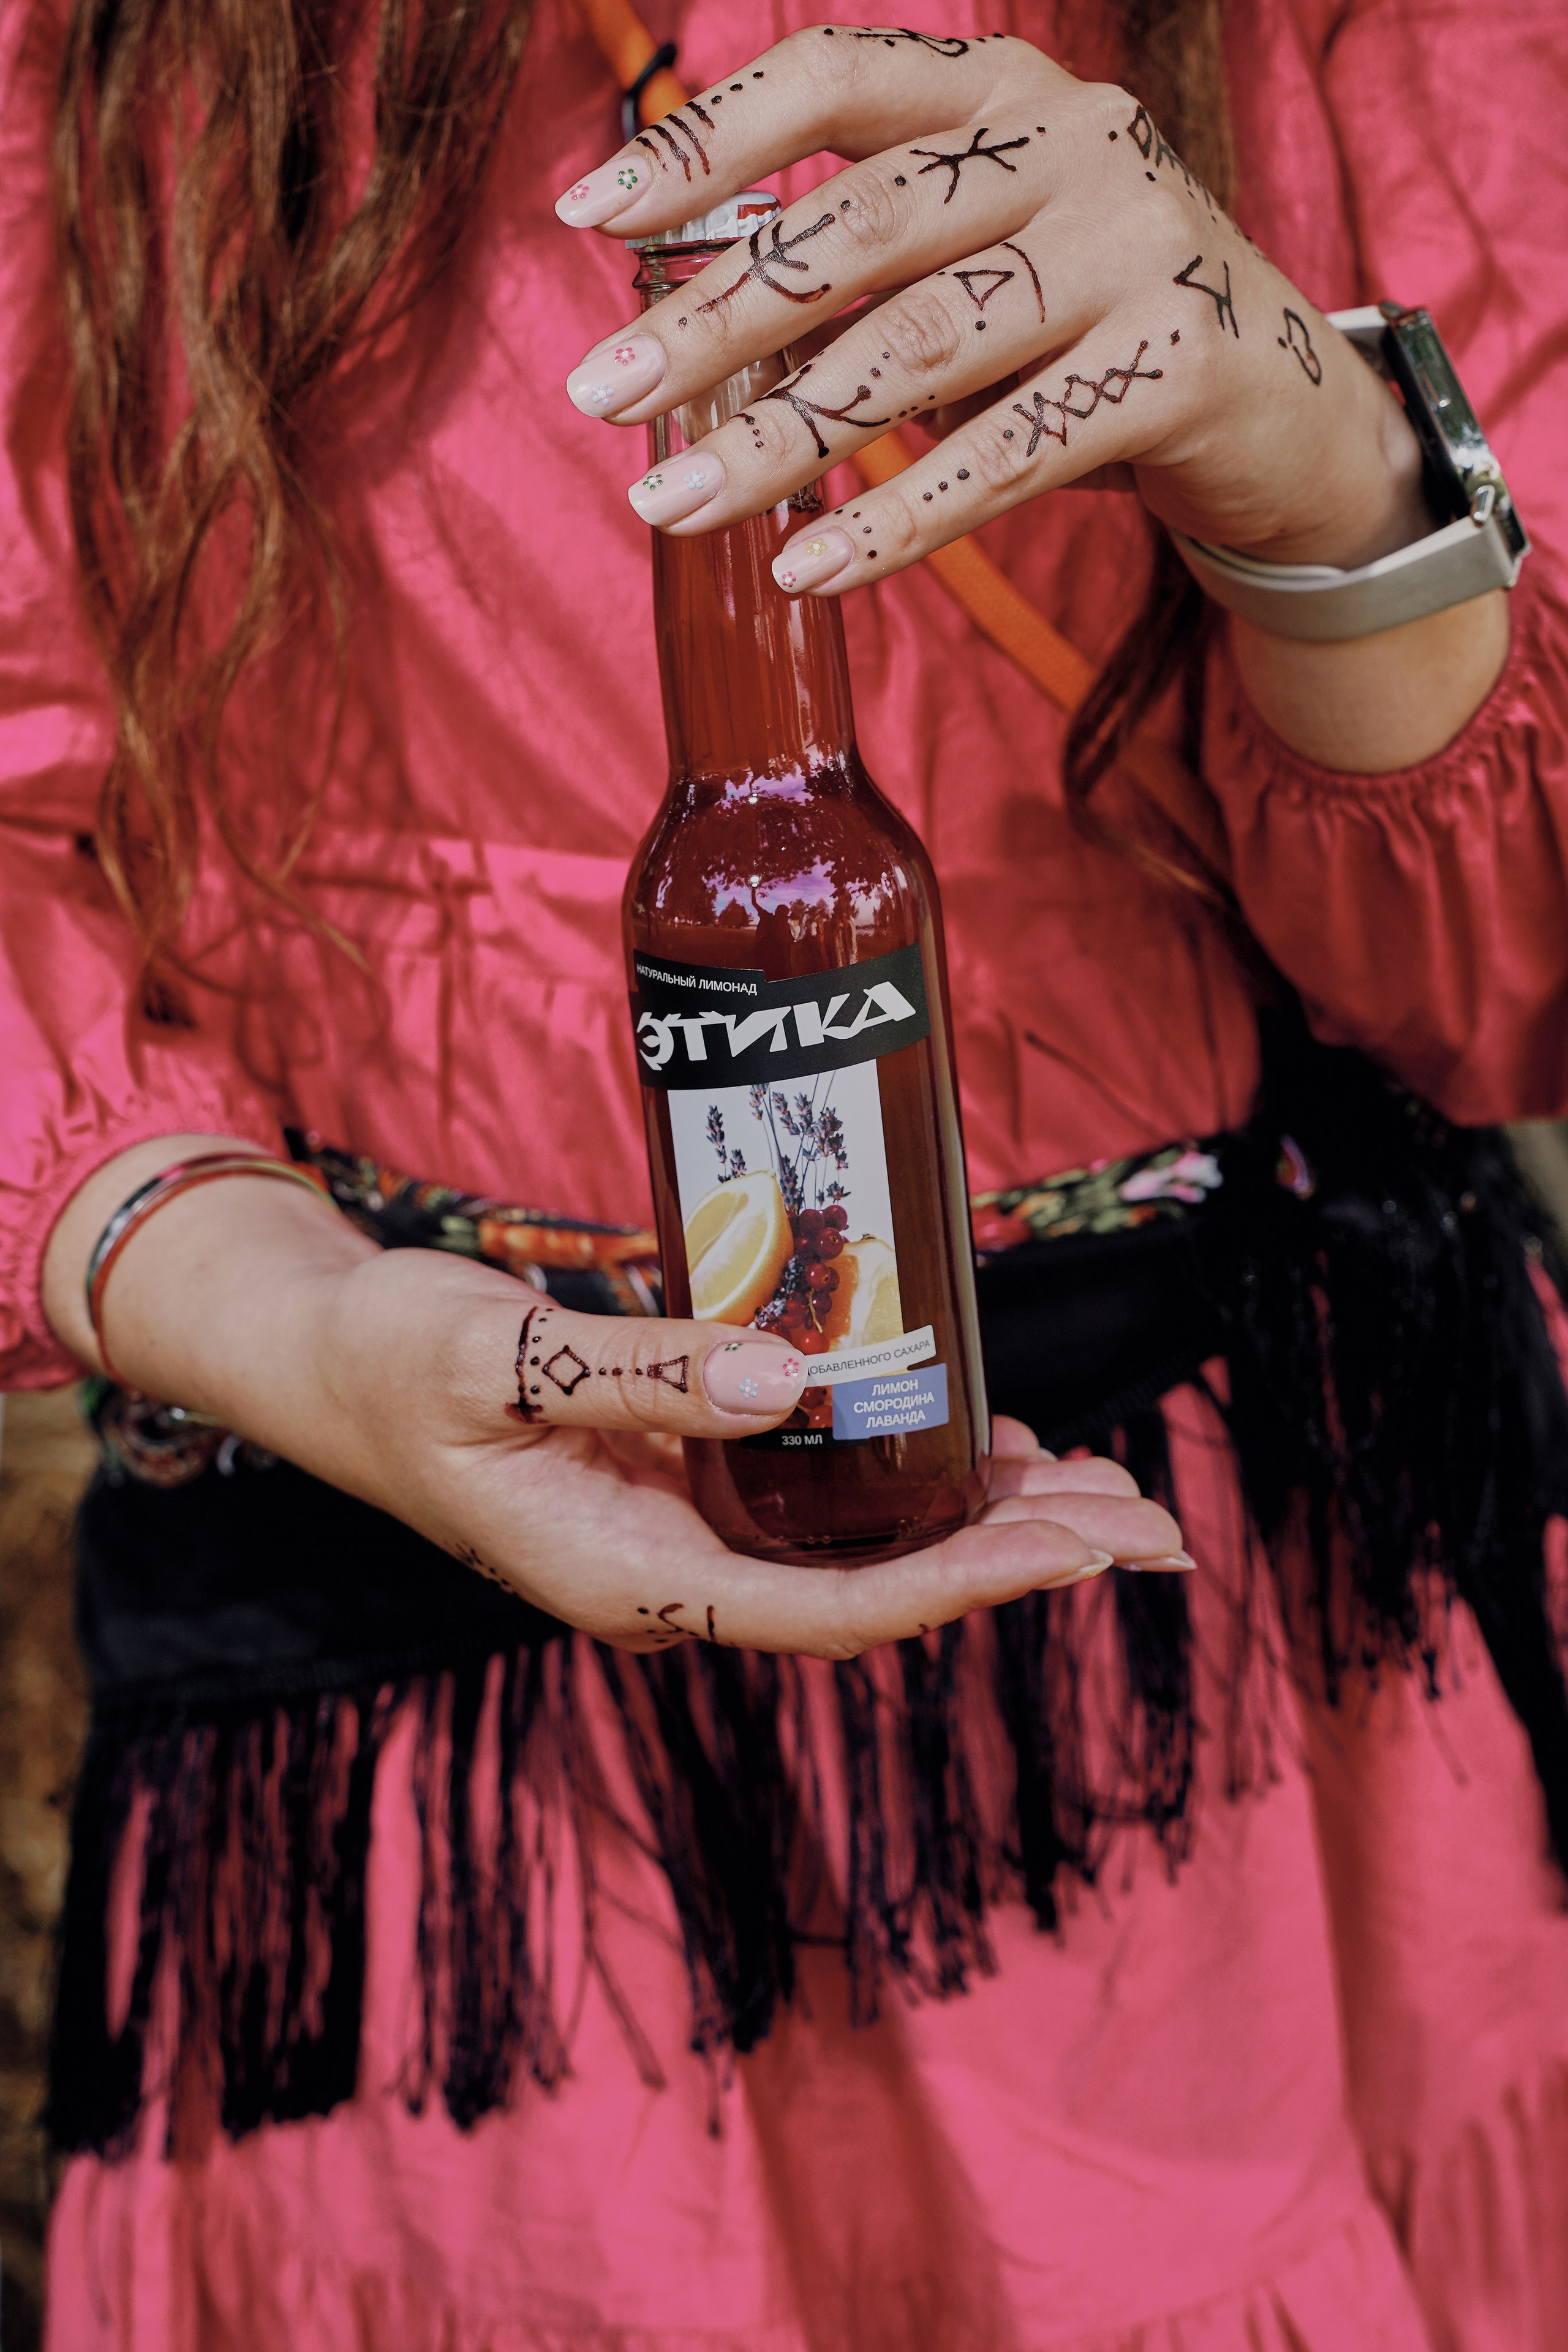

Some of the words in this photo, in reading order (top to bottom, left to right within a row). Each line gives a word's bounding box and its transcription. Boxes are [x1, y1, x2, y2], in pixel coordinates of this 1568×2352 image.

[636, 963, 696, 988] НАТУРАЛЬНЫЙ
[698, 979, 758, 996] ЛИМОНАД
[637, 981, 916, 1071] ЭТИКА
[894, 1339, 931, 1359] САХАРА
[872, 1379, 919, 1396] ЛИМОН
[853, 1391, 935, 1414] СМОРОДИНА
[865, 1409, 925, 1429] ЛАВАНДА
[781, 1434, 802, 1446] 330
[804, 1434, 823, 1446] МЛ
